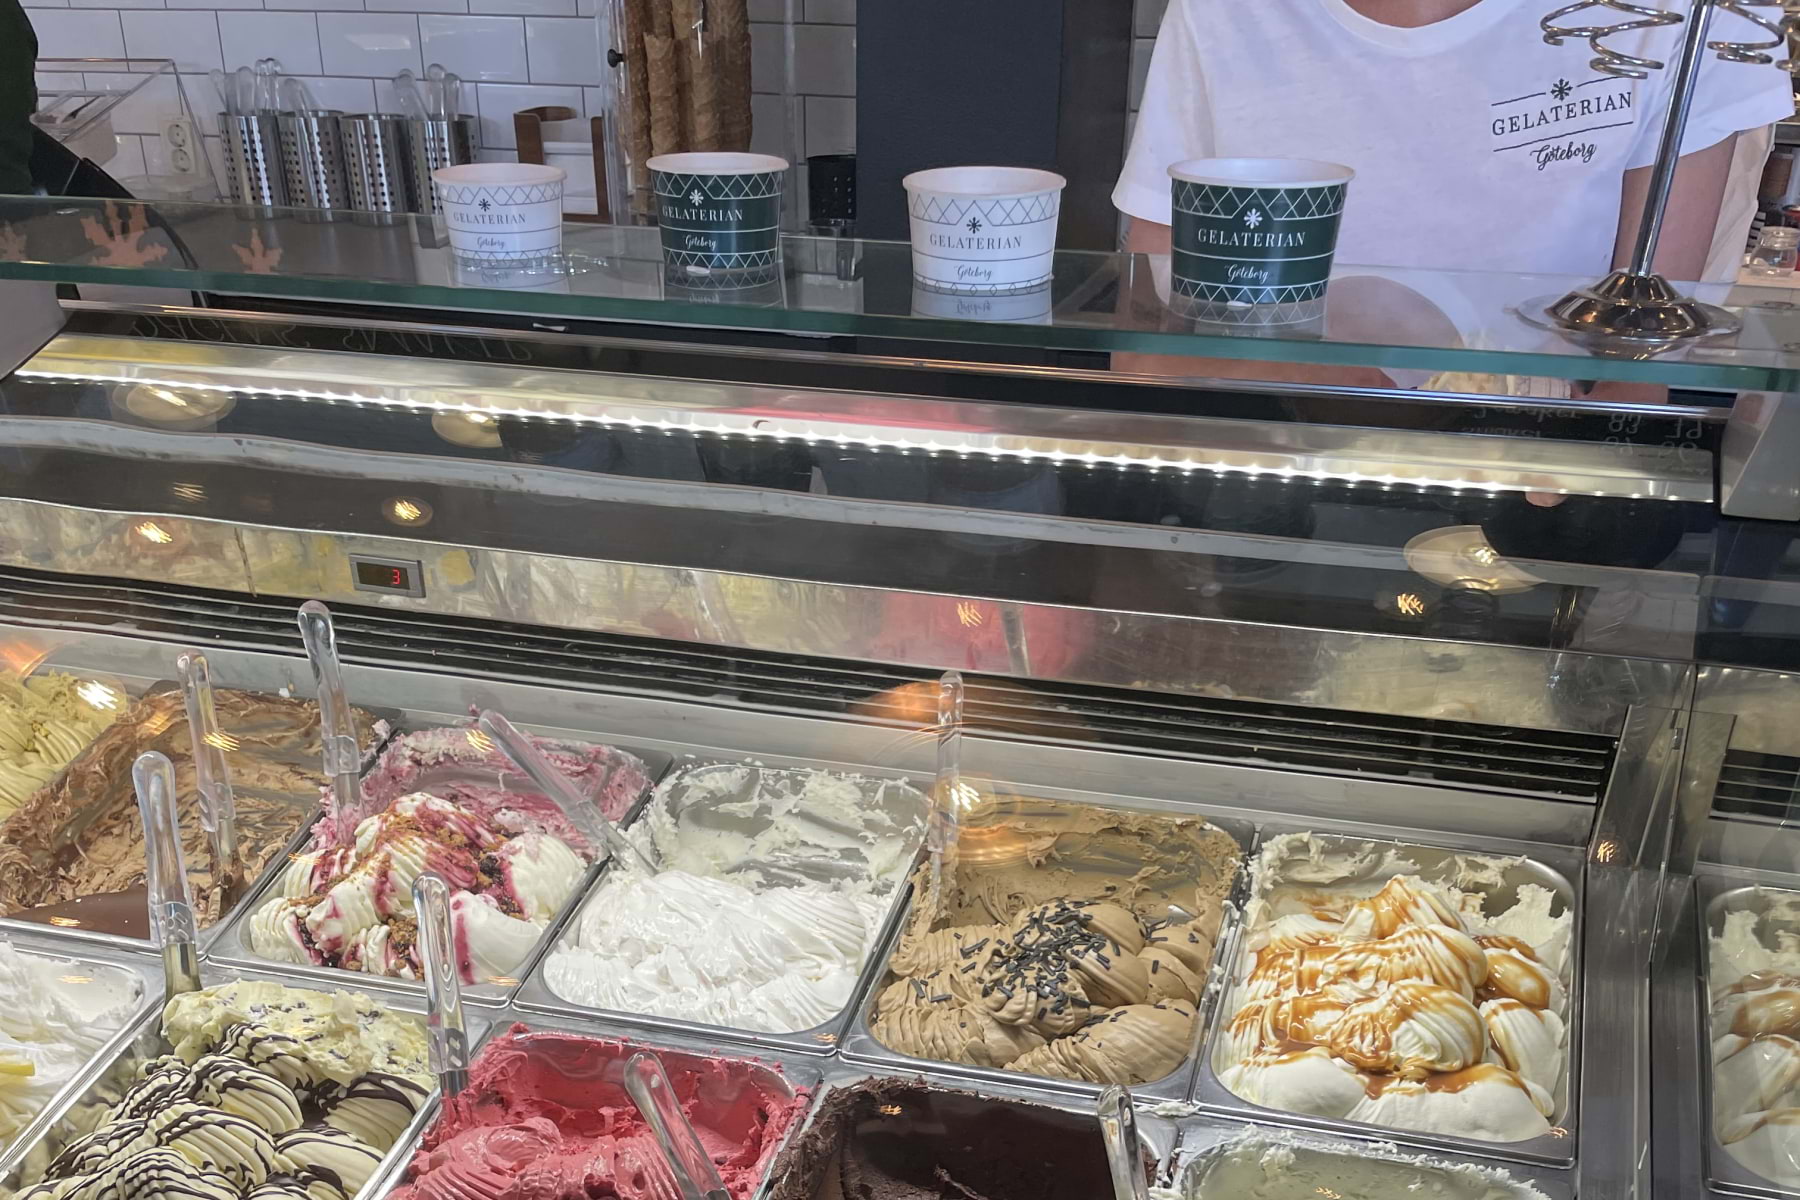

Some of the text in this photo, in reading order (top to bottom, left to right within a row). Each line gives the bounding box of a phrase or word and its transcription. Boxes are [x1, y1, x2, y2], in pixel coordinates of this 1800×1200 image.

[1492, 92, 1632, 136] GELATERIAN
[1530, 141, 1597, 171] Göteborg
[453, 211, 526, 225] GELATERIAN
[662, 205, 743, 221] GELATERIAN
[930, 233, 1022, 250] GELATERIAN
[1197, 228, 1306, 248] GELATERIAN
